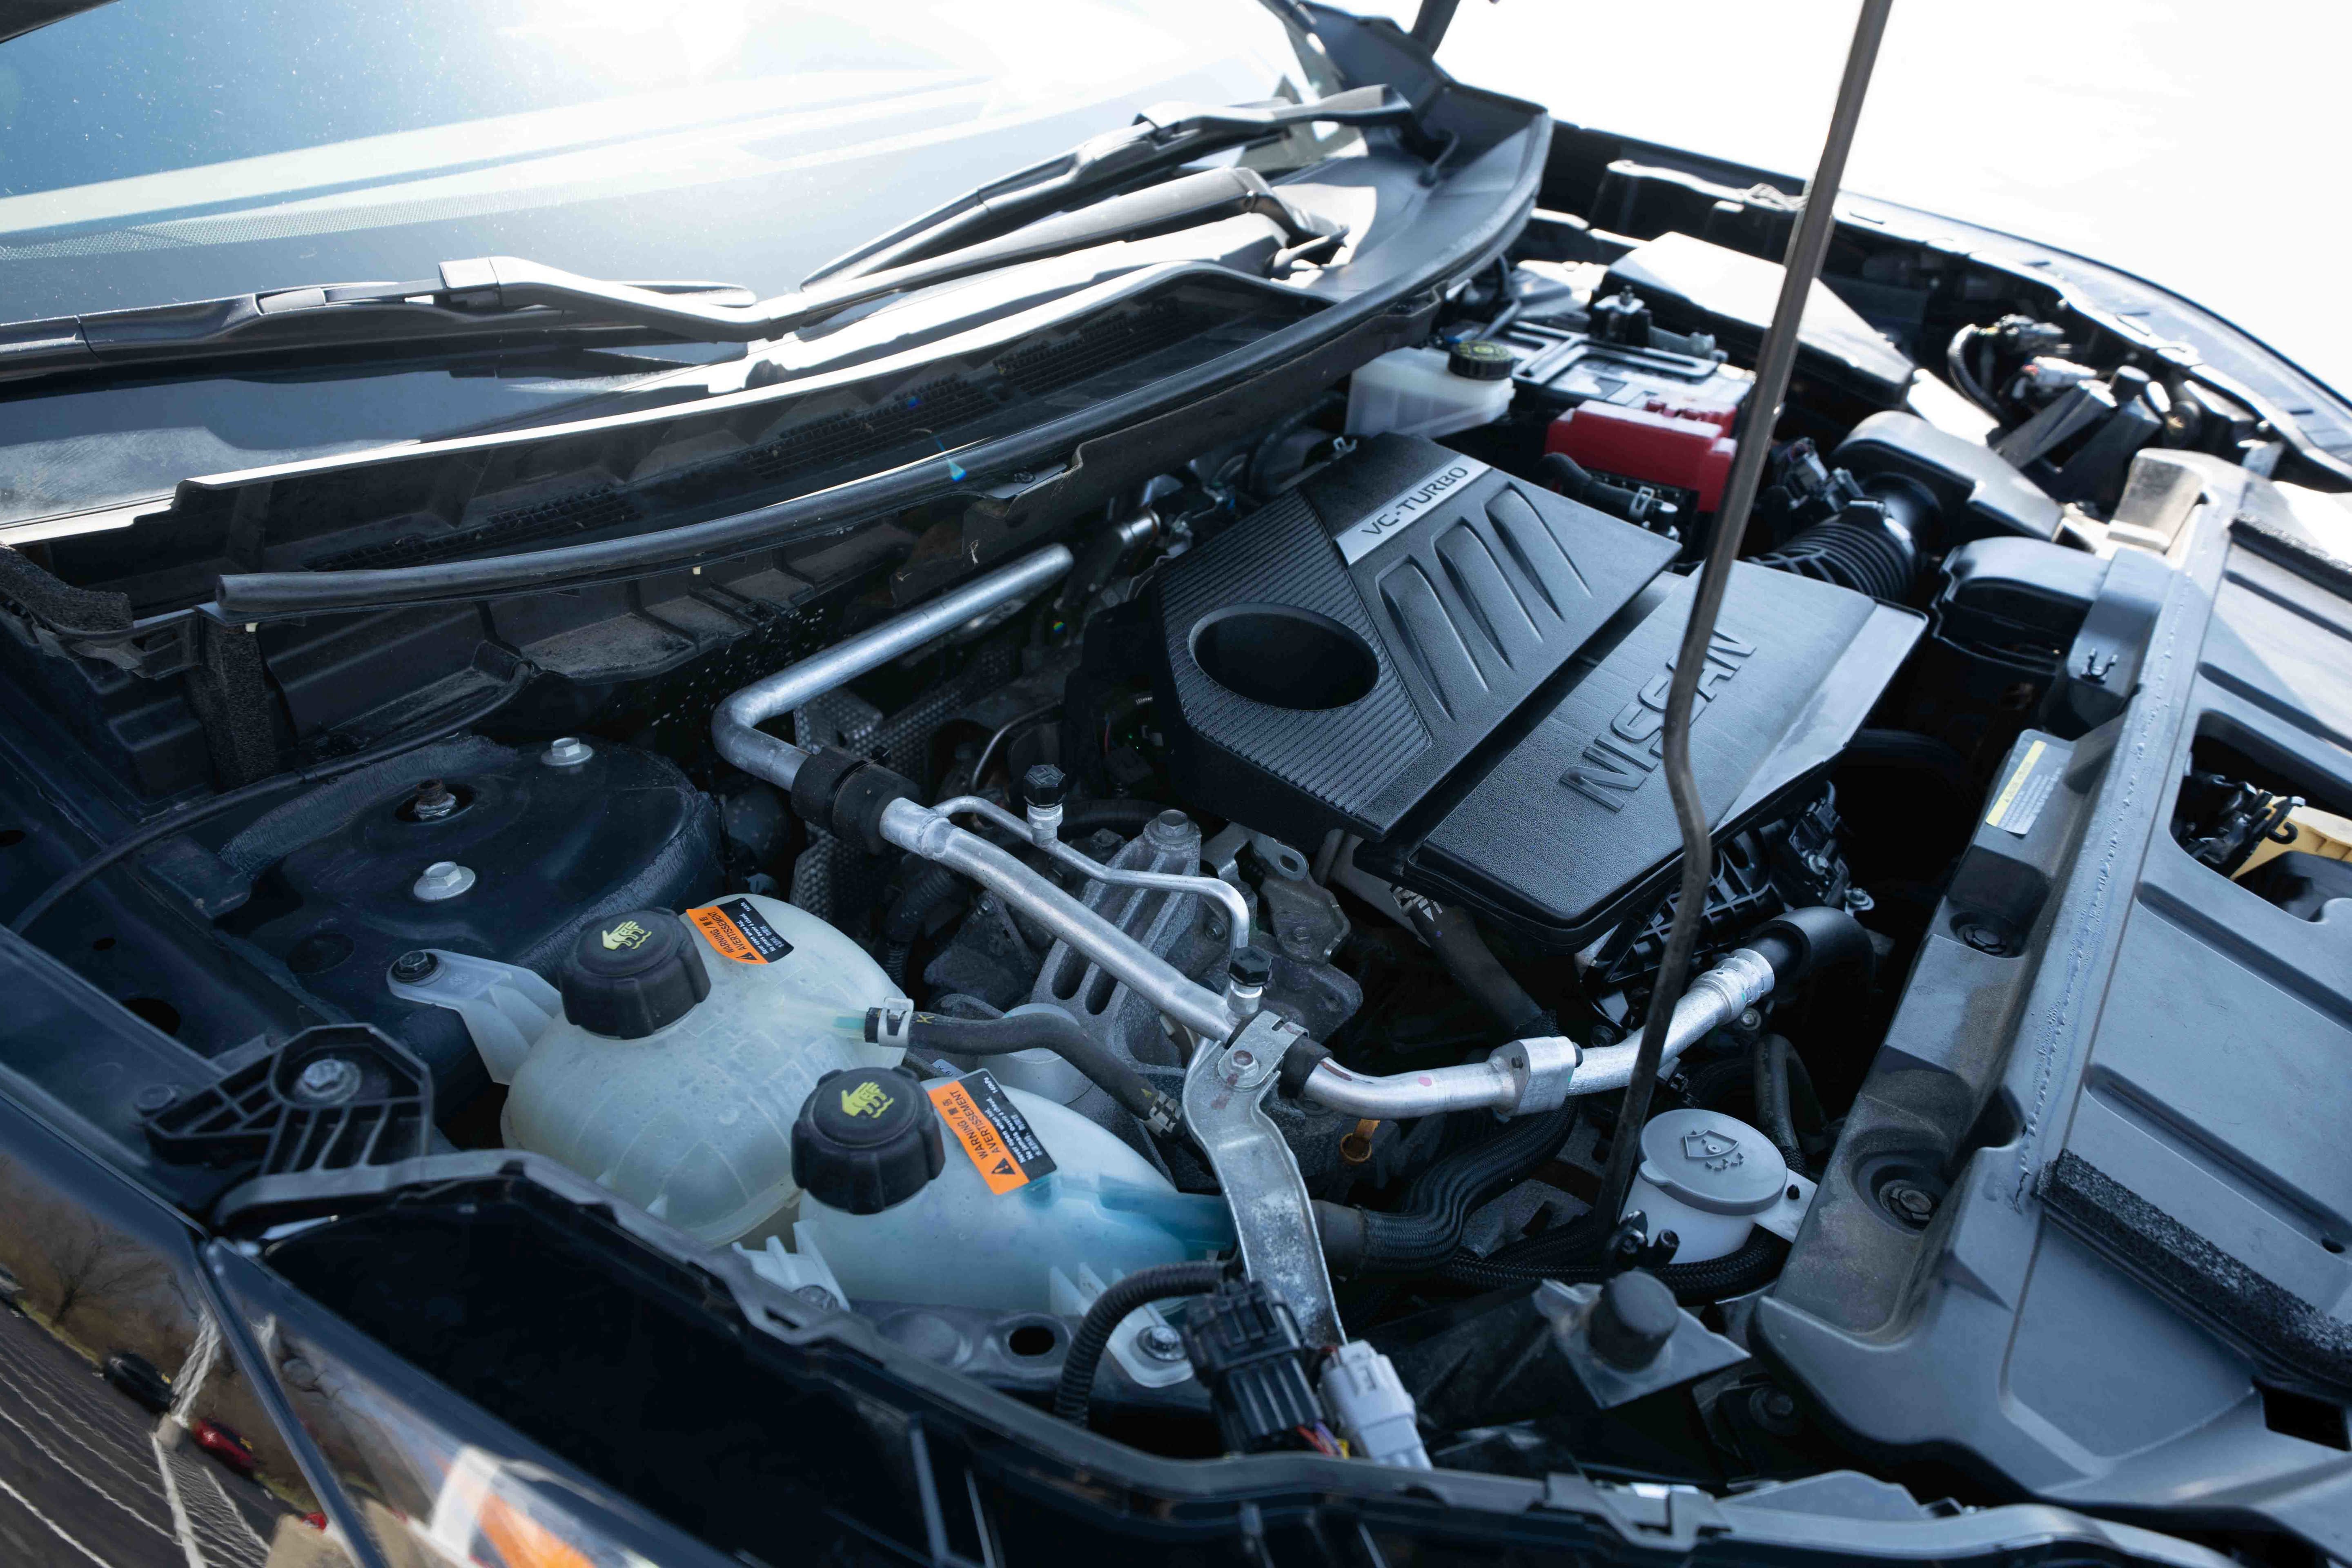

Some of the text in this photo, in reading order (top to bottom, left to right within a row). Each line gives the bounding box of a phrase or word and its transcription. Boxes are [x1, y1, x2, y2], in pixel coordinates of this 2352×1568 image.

[1360, 467, 1468, 535] VC-TURBO
[741, 902, 751, 911] 140kPa
[739, 913, 752, 923] chaud.
[707, 911, 746, 950] AVERTISSEMENT
[743, 927, 753, 936] when
[751, 927, 762, 936] ouvrir
[710, 929, 735, 953] WARNING
[751, 936, 760, 945] open
[760, 937, 773, 947] jamais
[758, 945, 768, 954] Never
[950, 1091, 1000, 1153] AVERTISSEMENT
[992, 1116, 1004, 1130] when
[1002, 1115, 1015, 1131] ouvrir
[958, 1120, 988, 1159] WARNING
[1002, 1131, 1014, 1146] open
[1013, 1132, 1029, 1151] jamais
[1012, 1147, 1026, 1163] Never
[1026, 1151, 1033, 1160] Ne
